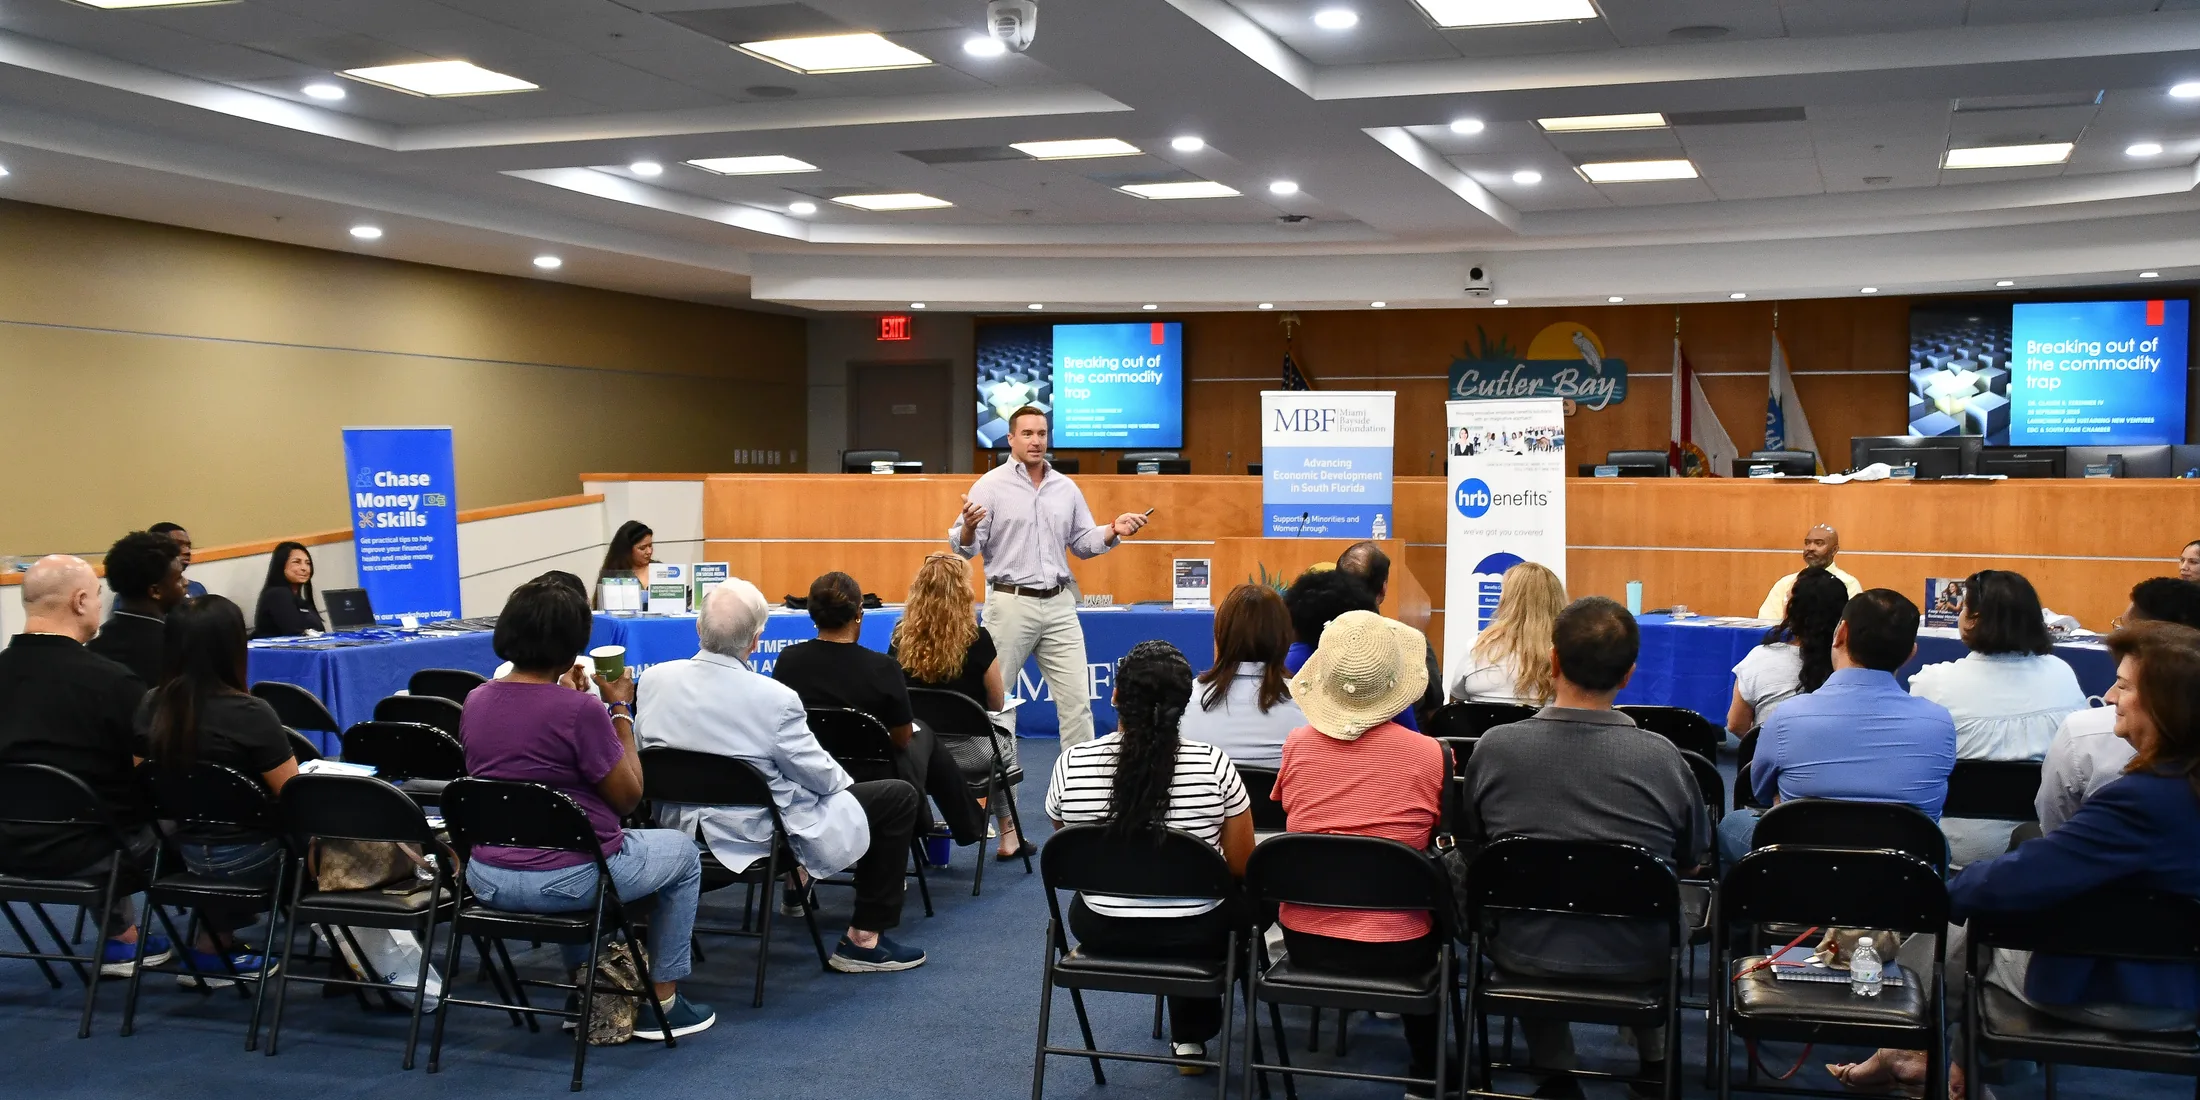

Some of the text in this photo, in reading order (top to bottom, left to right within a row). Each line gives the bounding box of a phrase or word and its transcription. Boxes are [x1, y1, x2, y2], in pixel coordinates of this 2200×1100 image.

[882, 318, 905, 338] EXIT
[2026, 337, 2159, 357] Breaking out of
[1063, 355, 1161, 371] Breaking out of
[2026, 355, 2161, 373] the commodity
[1064, 370, 1163, 385] the commodity
[2026, 374, 2062, 391] trap
[1064, 387, 1091, 400] trap
[1456, 364, 1616, 411] Cutler Bay
[1339, 408, 1366, 416] Miami
[1273, 408, 1337, 432] MBF
[1339, 417, 1371, 425] Bayside
[1339, 425, 1386, 433] Foundation
[1303, 458, 1352, 469] Advancing
[374, 471, 430, 487] Chase
[1273, 470, 1382, 481] Economic Development
[1290, 483, 1365, 493] in South Florida
[356, 492, 419, 511] Money
[376, 511, 427, 528] Skills
[1300, 525, 1329, 534] hrough:
[1485, 529, 1497, 537] got
[371, 536, 398, 544] practical
[419, 535, 434, 543] help
[401, 544, 428, 552] financial
[431, 610, 452, 618] today
[1016, 662, 1112, 702] MF
